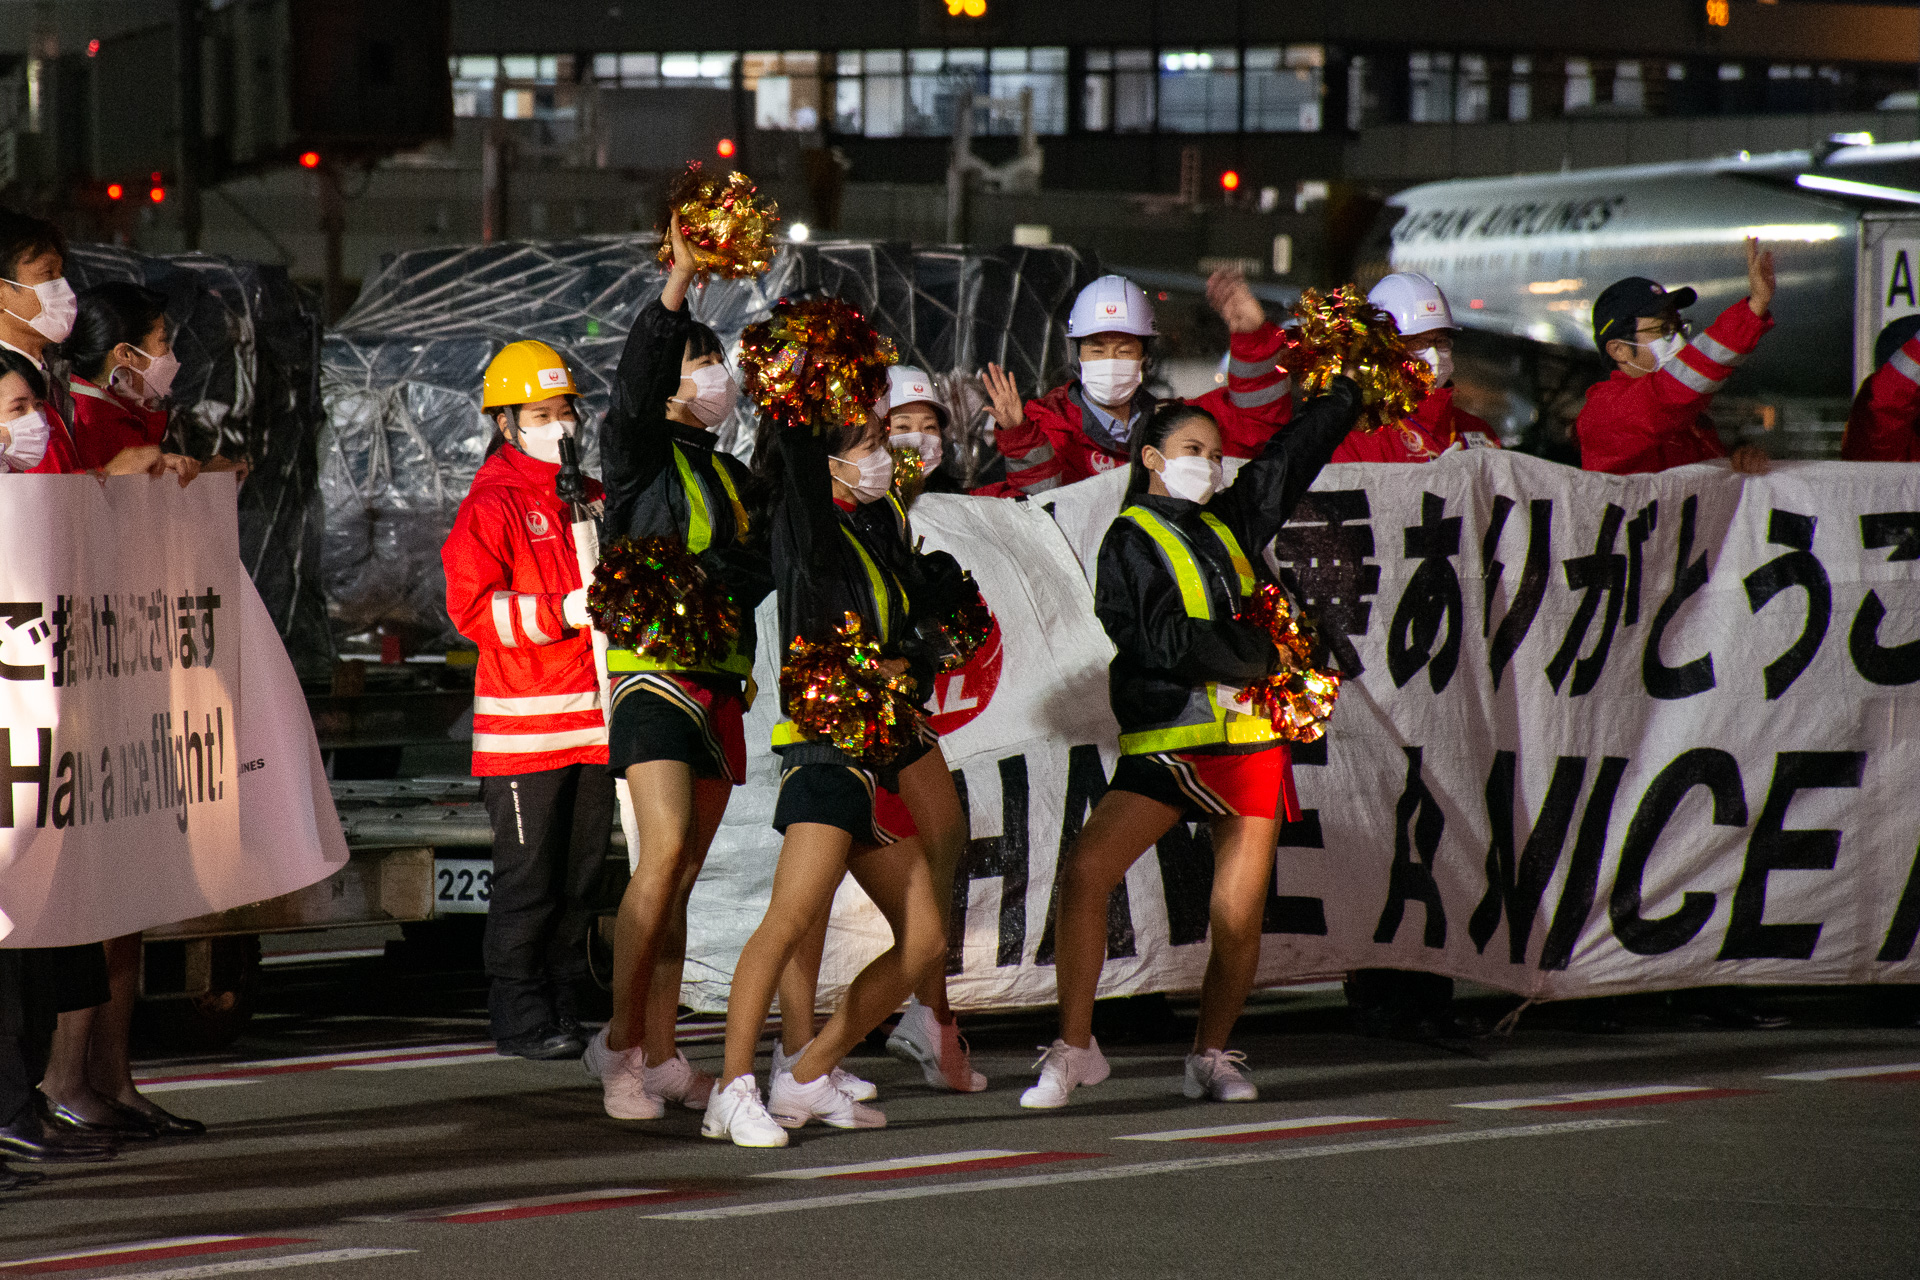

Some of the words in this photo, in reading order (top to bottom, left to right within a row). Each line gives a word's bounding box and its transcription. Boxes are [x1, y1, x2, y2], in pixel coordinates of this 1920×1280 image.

[1395, 207, 1477, 243] APAN
[1886, 250, 1920, 307] A
[100, 746, 115, 823] a
[152, 706, 224, 834] flight!
[240, 758, 265, 774] INES
[1373, 745, 1446, 948] A
[1468, 748, 1868, 970] NICE
[438, 868, 492, 901] 223
